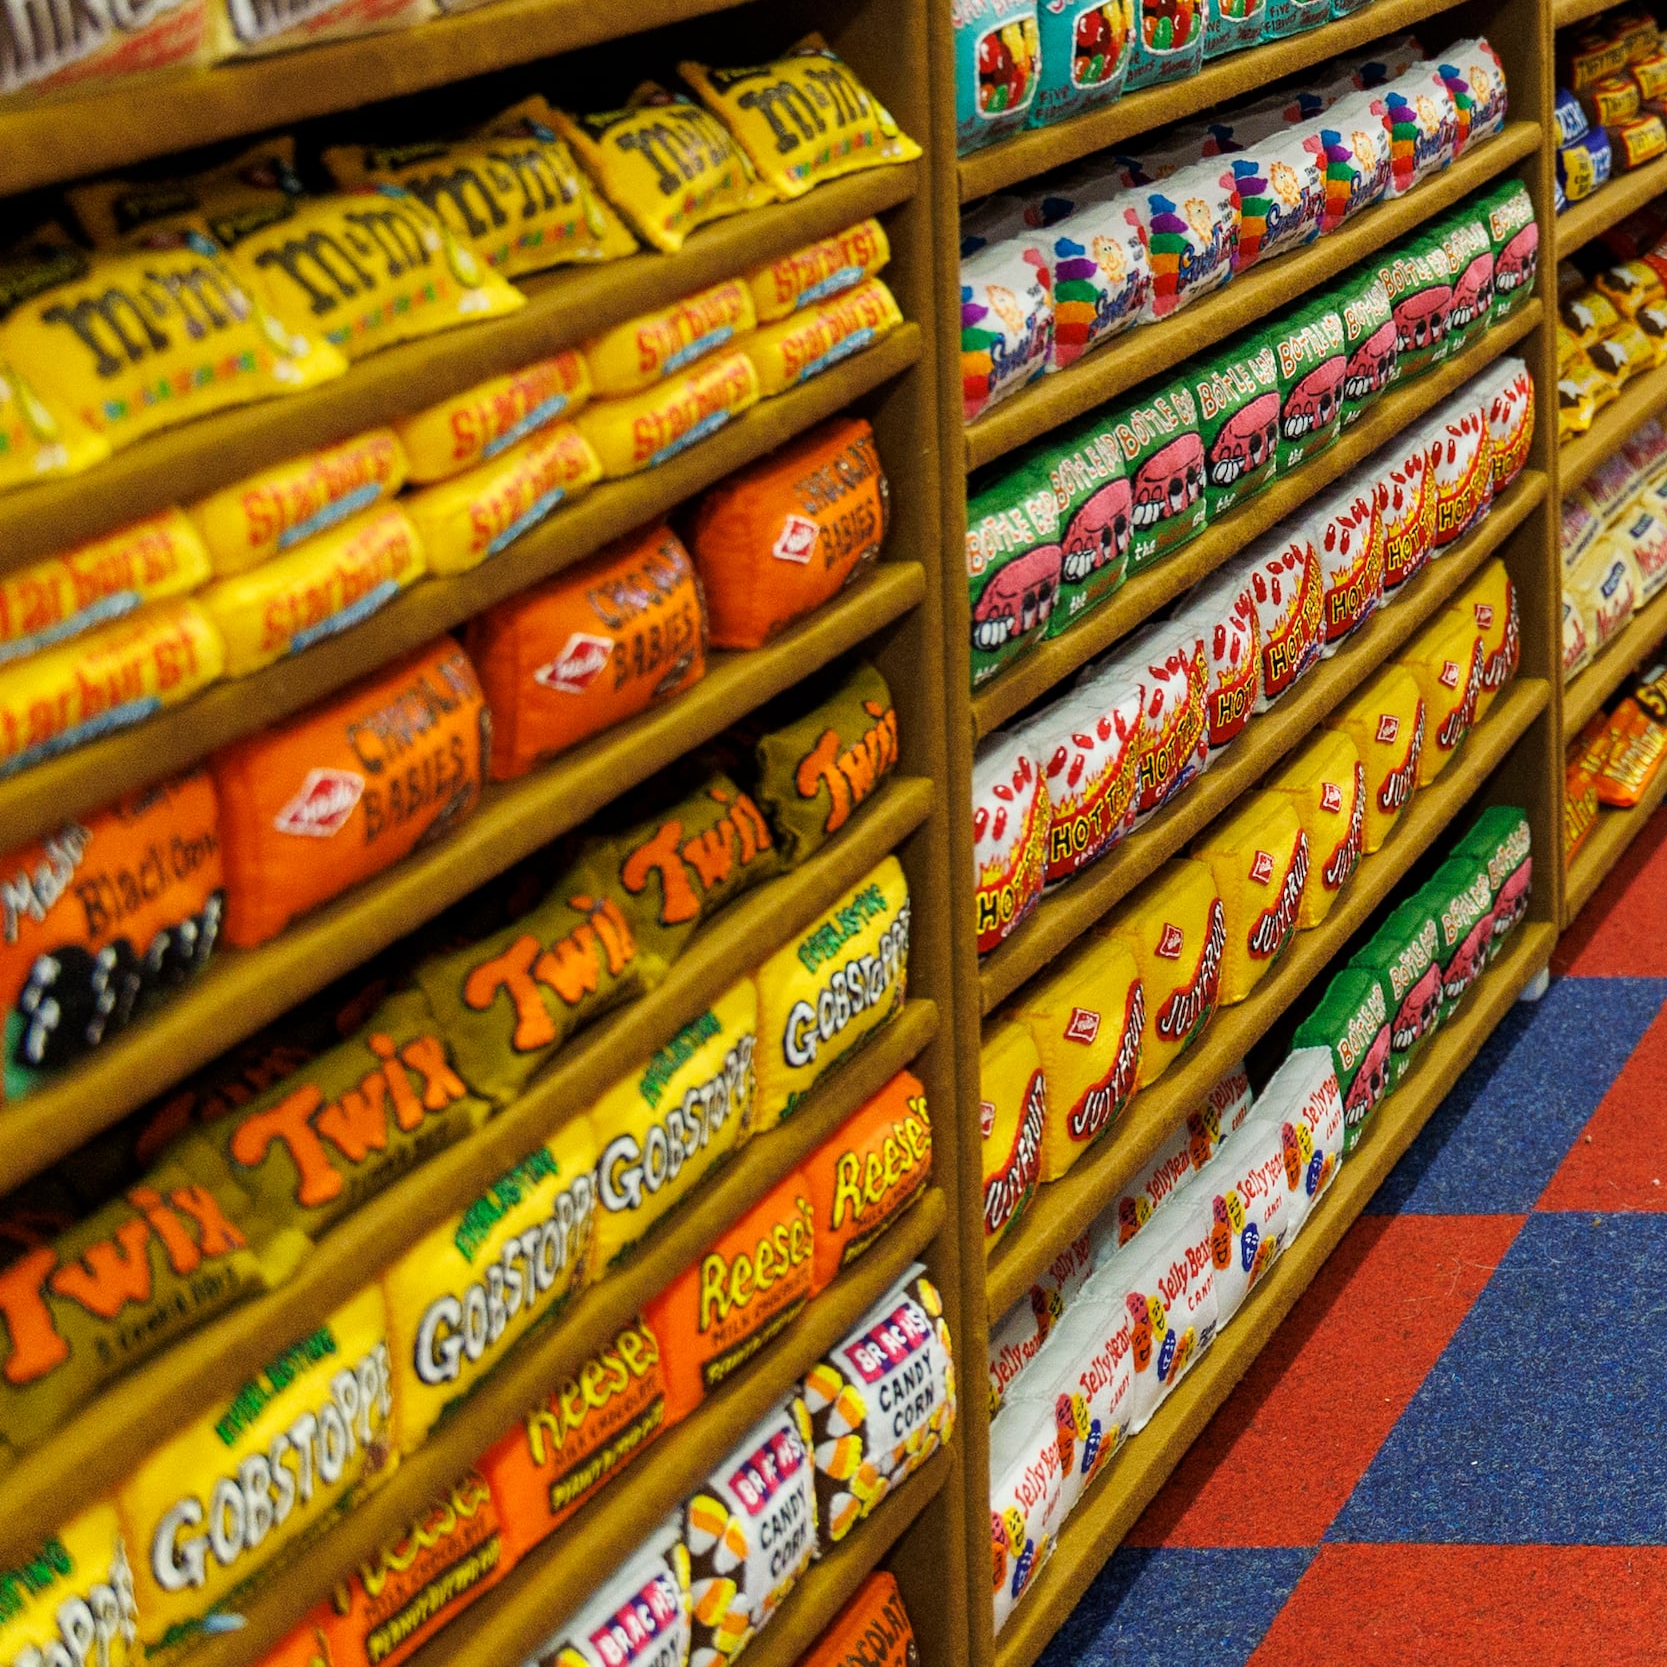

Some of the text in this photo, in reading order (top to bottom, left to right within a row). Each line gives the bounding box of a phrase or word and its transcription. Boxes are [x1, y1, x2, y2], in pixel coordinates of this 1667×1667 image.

[1199, 364, 1256, 420] BOTTLE
[1122, 401, 1175, 460] BOTTLE
[966, 506, 1030, 574] BOTTLE
[1439, 500, 1475, 532] HOT
[1388, 536, 1420, 573] HOT
[1331, 587, 1366, 625] HOT
[1269, 631, 1309, 680] HOT
[1216, 688, 1253, 729] HOT
[1052, 804, 1105, 860] HOT
[1250, 830, 1310, 958] JUJYFRUIT
[1159, 898, 1226, 1039] JUJYFRUIT
[1070, 981, 1146, 1136] JUJYFRUIT
[230, 1028, 468, 1209] Twix
[599, 1036, 757, 1212] GOBSTOPP
[414, 1168, 600, 1386] GOBSTOPP
[879, 1349, 934, 1414] CANDY
[893, 1388, 936, 1439] CORN
[151, 1341, 393, 1592] GOBSTOPPE
